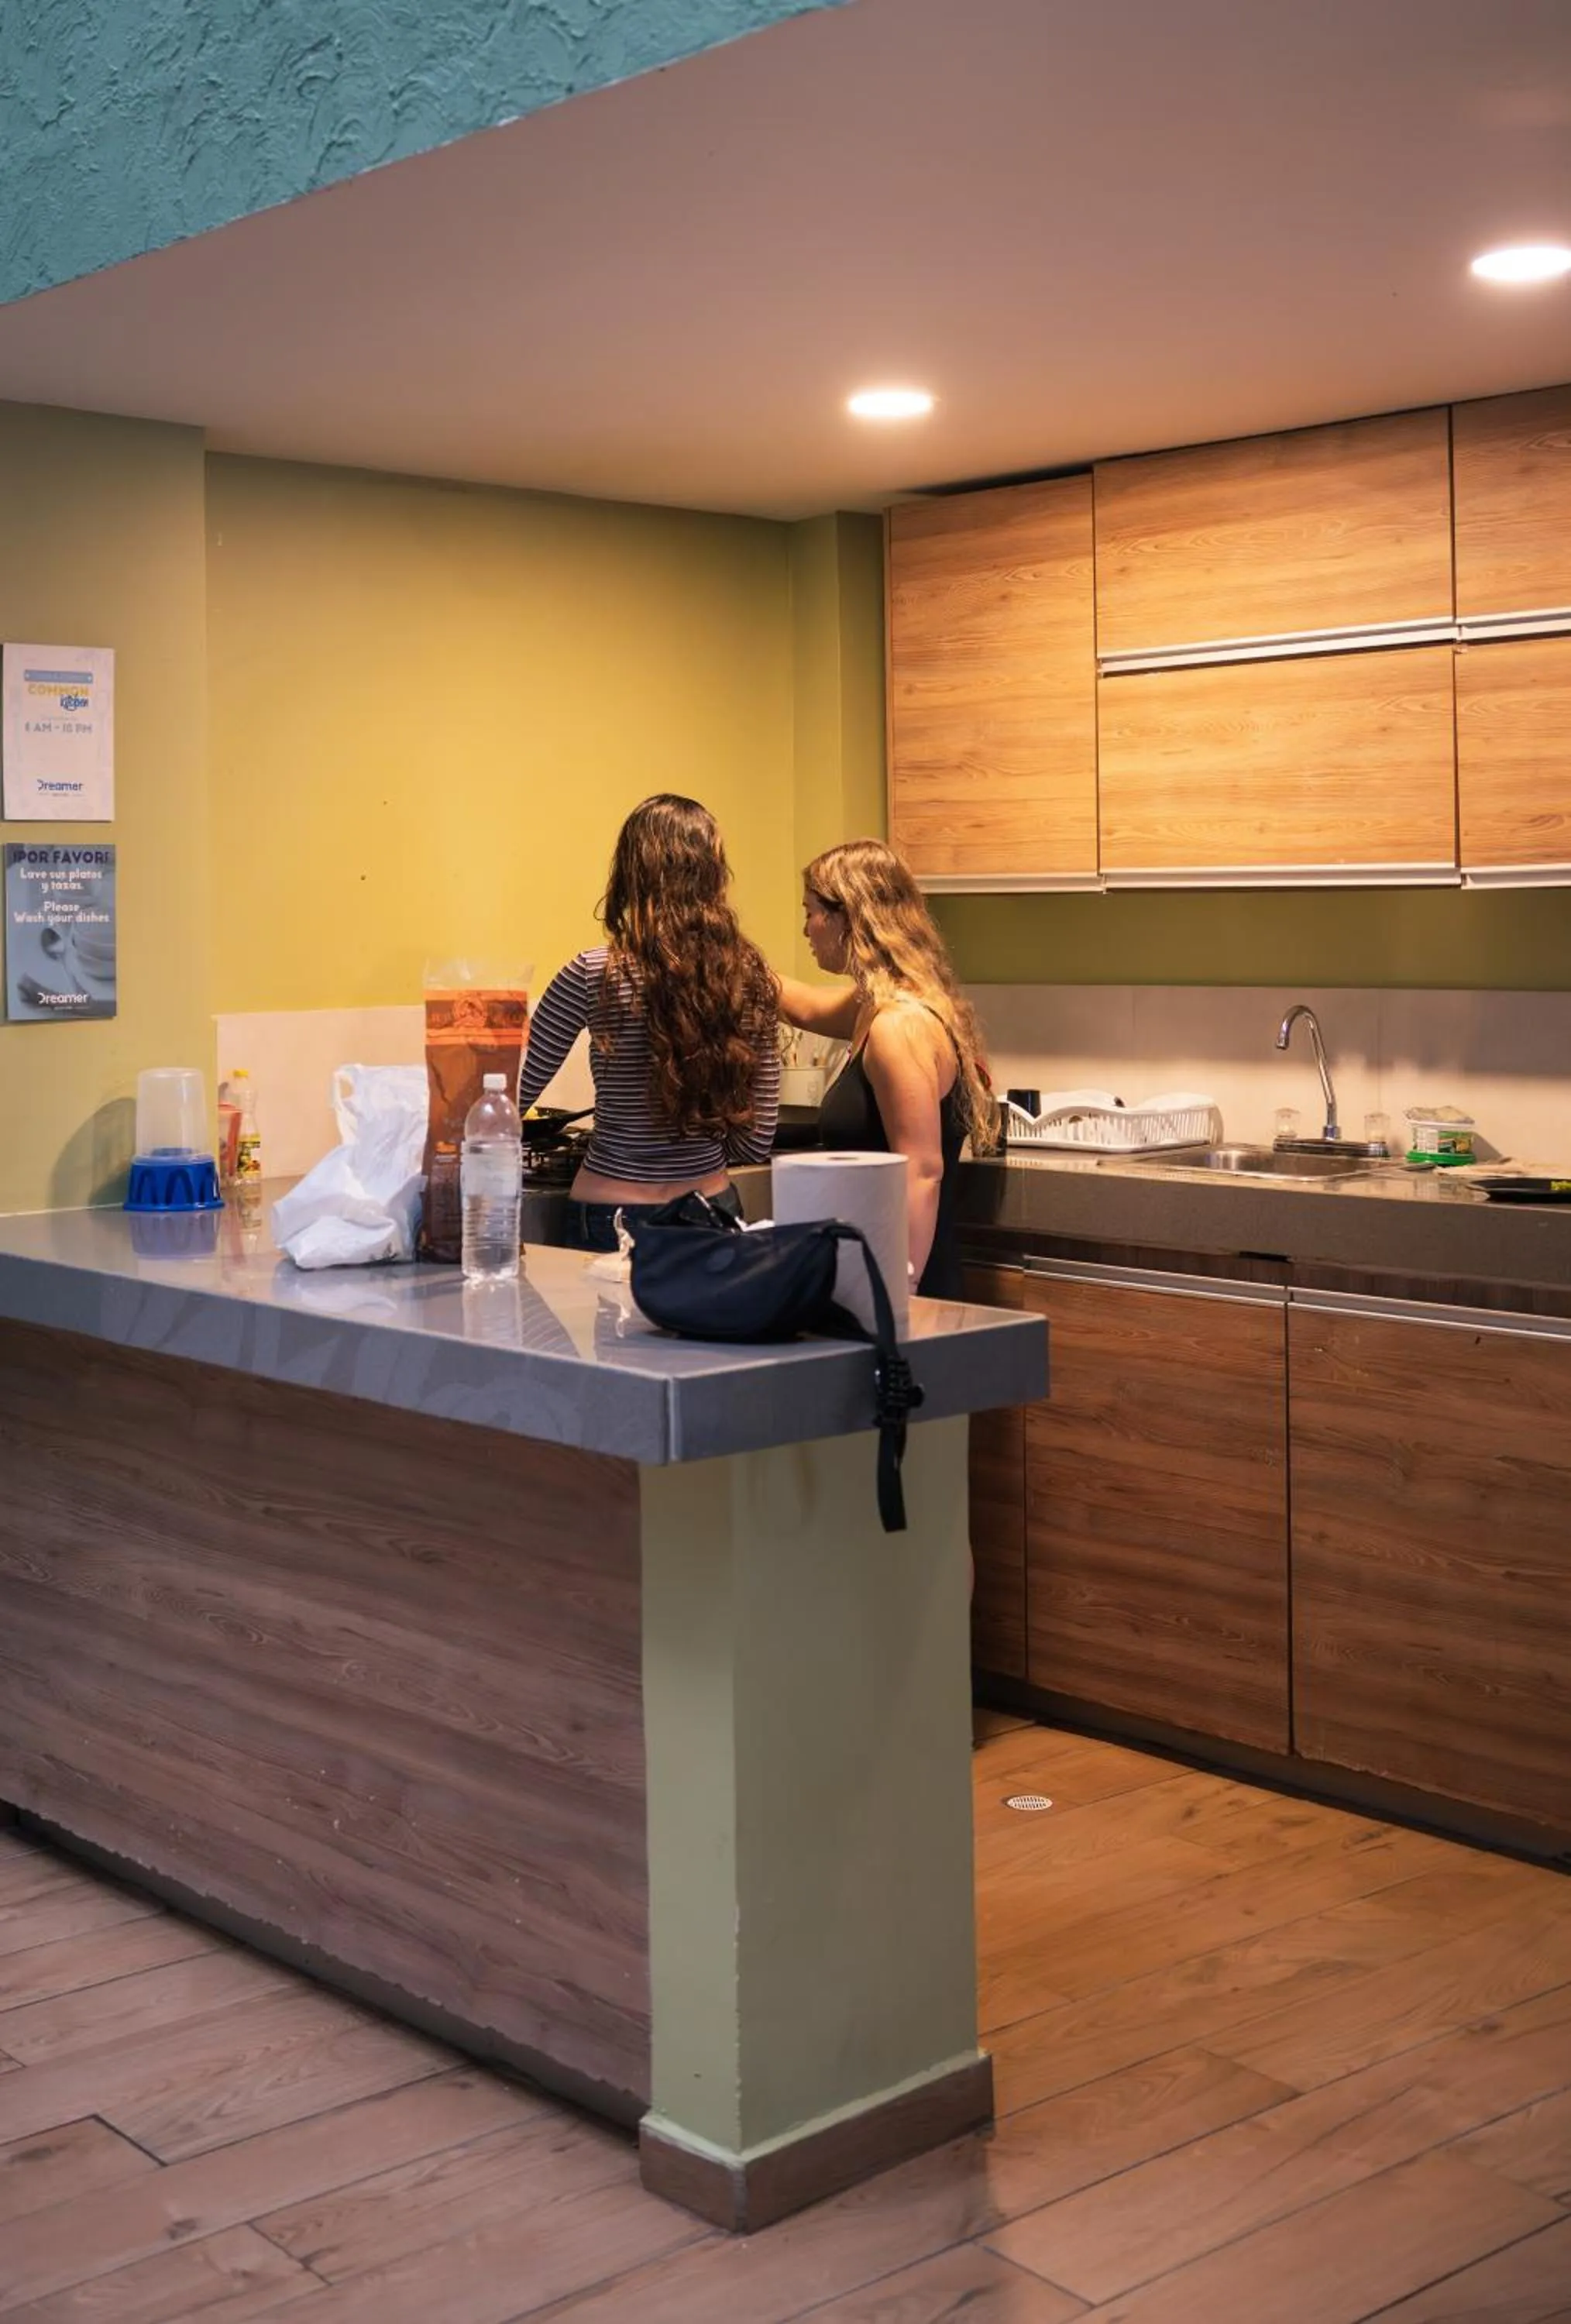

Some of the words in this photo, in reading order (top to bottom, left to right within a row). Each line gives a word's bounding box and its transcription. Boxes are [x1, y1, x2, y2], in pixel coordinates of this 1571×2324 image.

[28, 683, 89, 696] COMMON
[33, 723, 52, 732] AM
[75, 724, 92, 733] PM
[36, 779, 84, 791] Dreamer
[20, 868, 47, 879] Lave
[49, 871, 67, 879] sus
[69, 868, 102, 882] platos
[41, 882, 49, 893] y
[43, 901, 80, 912] Please
[14, 912, 44, 923] Wash
[46, 915, 73, 926] your
[75, 912, 110, 923] dishes
[37, 992, 88, 1004] Dreamer
